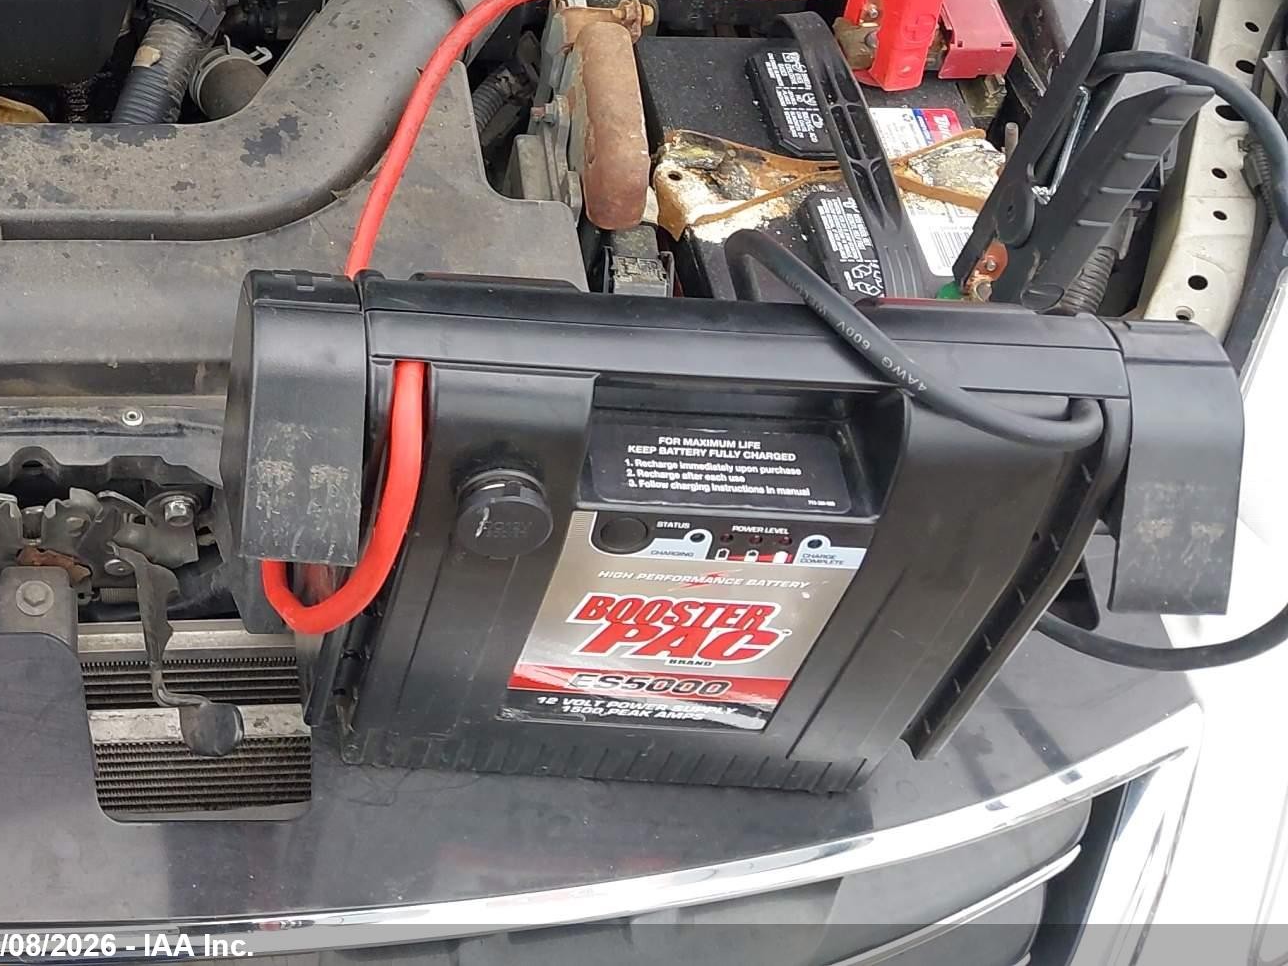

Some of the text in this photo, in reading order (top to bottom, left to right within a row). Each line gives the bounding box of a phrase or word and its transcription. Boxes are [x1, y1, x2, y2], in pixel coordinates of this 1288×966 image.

[836, 321, 871, 350] 600V
[658, 437, 761, 449] FOR MAXIMUM LIFE
[627, 445, 796, 461] KEEP BATTERY FULLY CHARGED
[624, 458, 802, 475] 1. Recharge immediately upon purchase
[626, 468, 635, 477] 2.
[636, 469, 680, 480] Recharge
[682, 471, 703, 480] after
[704, 472, 727, 482] each
[628, 479, 811, 496] 3. Follow charging instructions in manual
[657, 521, 690, 530] STATUS
[732, 525, 789, 535] POWER LEVEL
[650, 549, 695, 557] CHARGING
[800, 558, 844, 566] COMPLETE
[598, 570, 810, 590] HIGH PERFORMANCE BATTERY
[574, 595, 776, 631] BOOSTER
[579, 622, 780, 661] PAC
[669, 659, 712, 667] BRAND
[569, 673, 729, 696] ES5000
[537, 696, 738, 716] 12 VOLT POWER SUPPLY
[562, 705, 706, 721] 1500 PEAK AMPS
